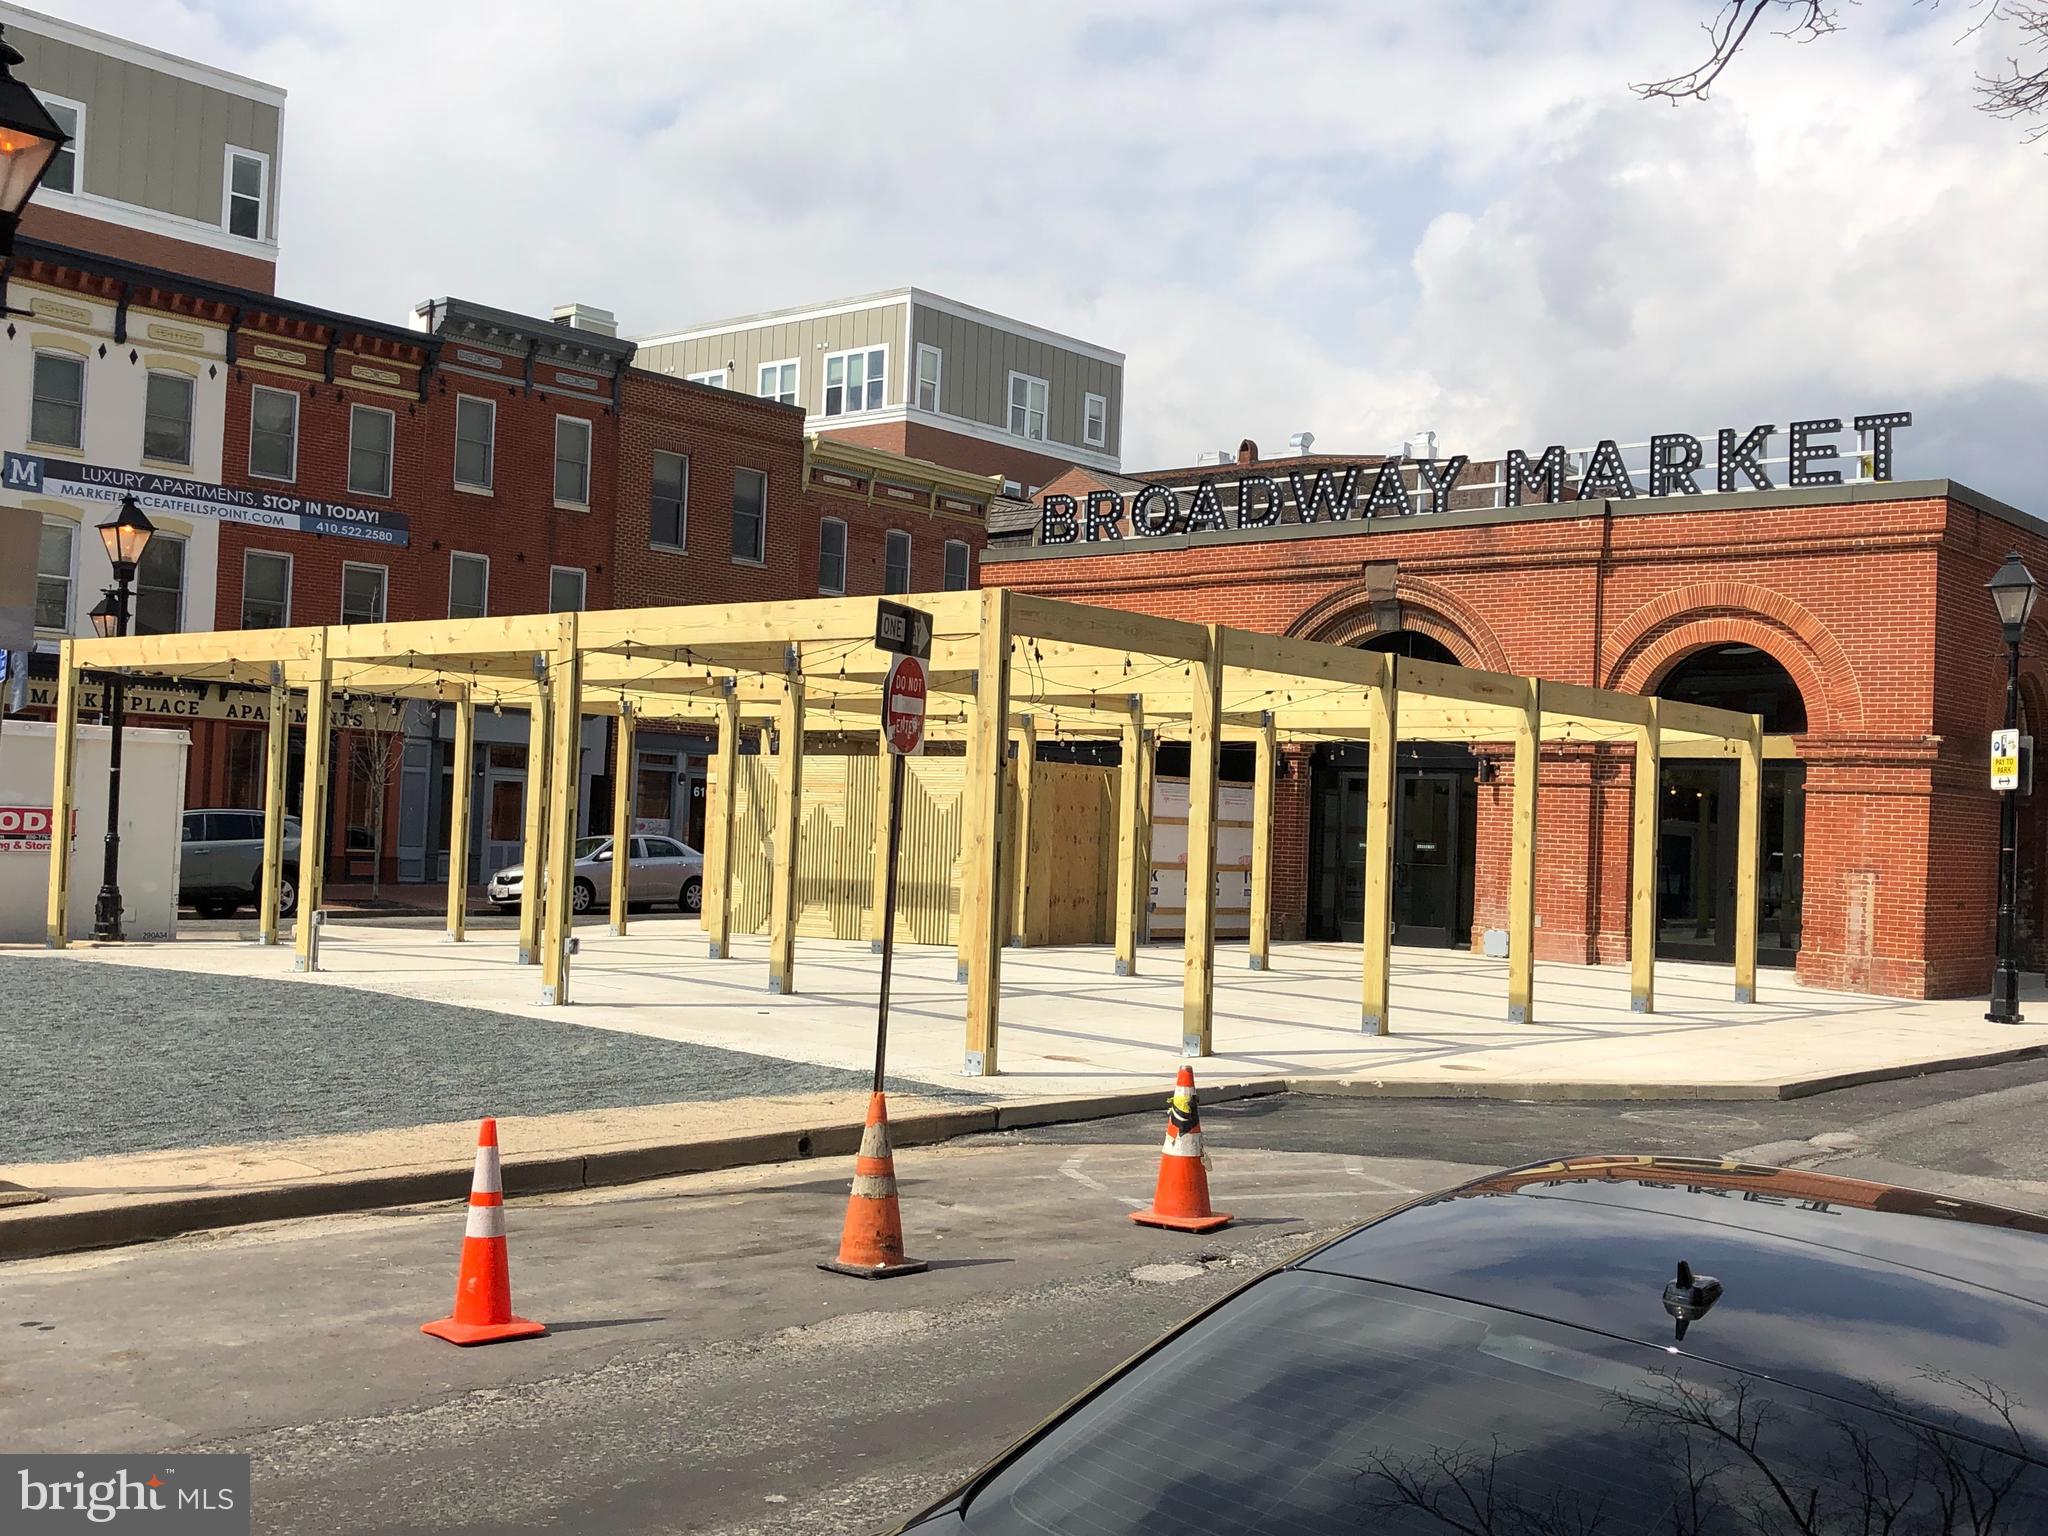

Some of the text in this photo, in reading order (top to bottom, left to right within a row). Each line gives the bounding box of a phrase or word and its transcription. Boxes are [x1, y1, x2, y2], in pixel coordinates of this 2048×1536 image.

[9, 458, 37, 487] M
[1042, 411, 1912, 545] BROADWAY MARKET
[82, 466, 380, 524] LUXURY APARTMENTS, STOP IN TODAY!
[316, 521, 393, 542] 410.522.2580
[884, 616, 902, 638] ONE
[896, 674, 923, 692] DO NOT
[1997, 766, 2012, 775] PARK
[0, 811, 53, 831] OD
[25, 840, 52, 850] Stora
